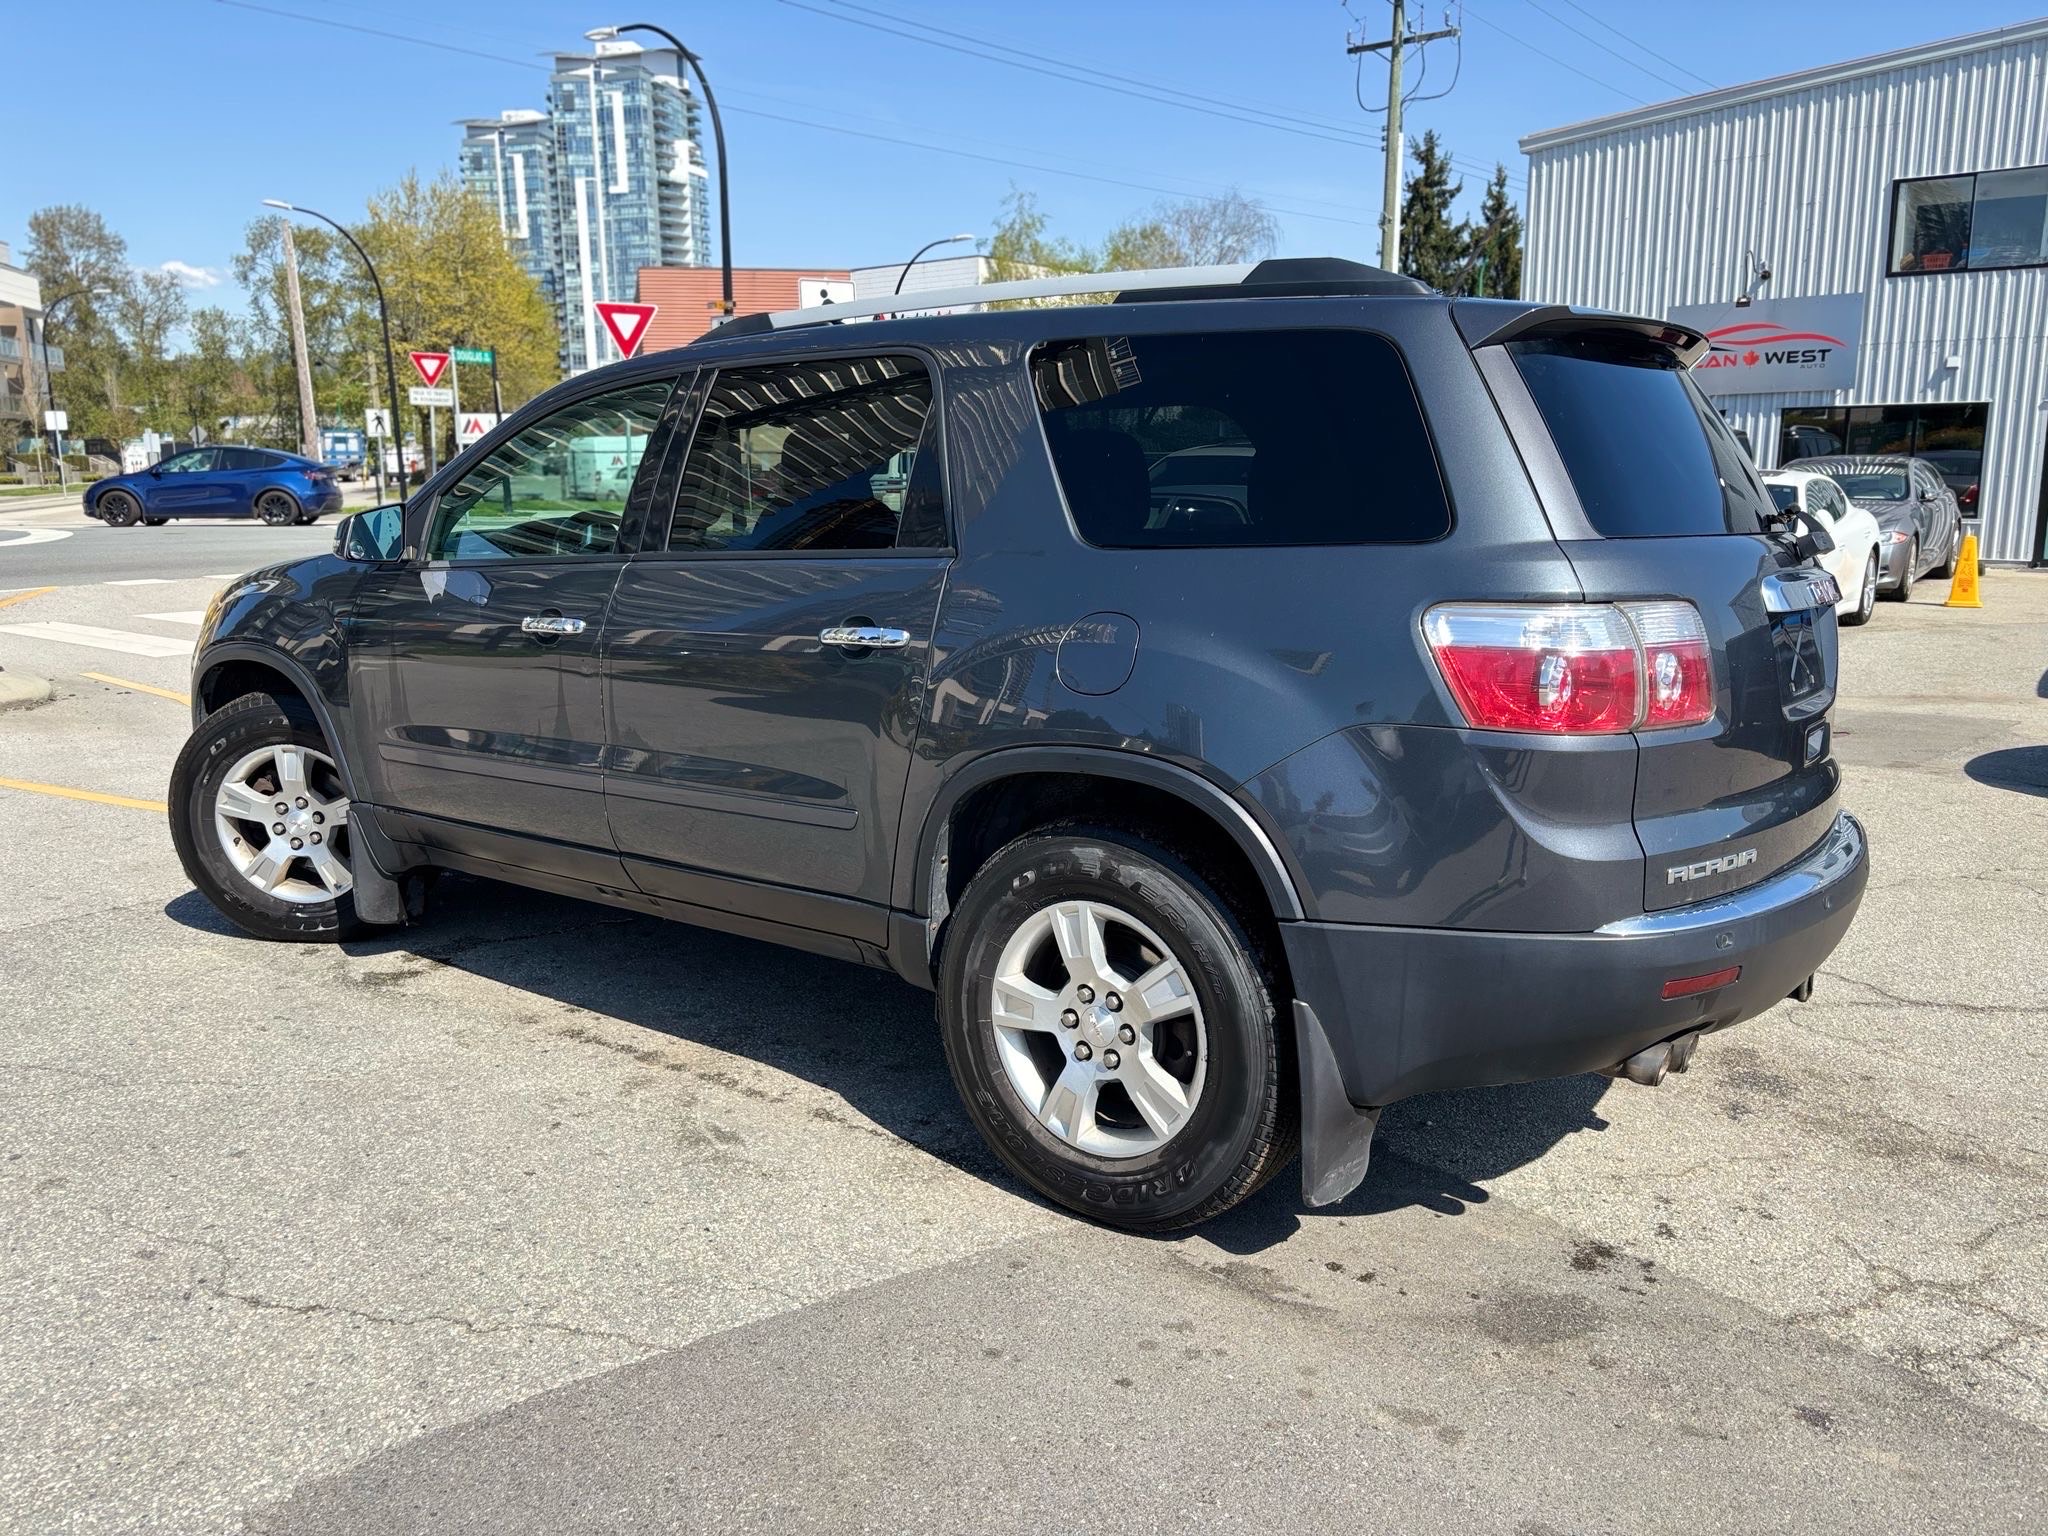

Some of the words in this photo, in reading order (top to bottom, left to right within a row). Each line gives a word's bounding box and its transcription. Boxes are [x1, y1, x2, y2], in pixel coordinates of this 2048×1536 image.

[456, 349, 483, 362] DOUGLAS
[1696, 354, 1738, 369] AN
[1765, 348, 1832, 364] WEST
[1666, 848, 1758, 885] ACADIA
